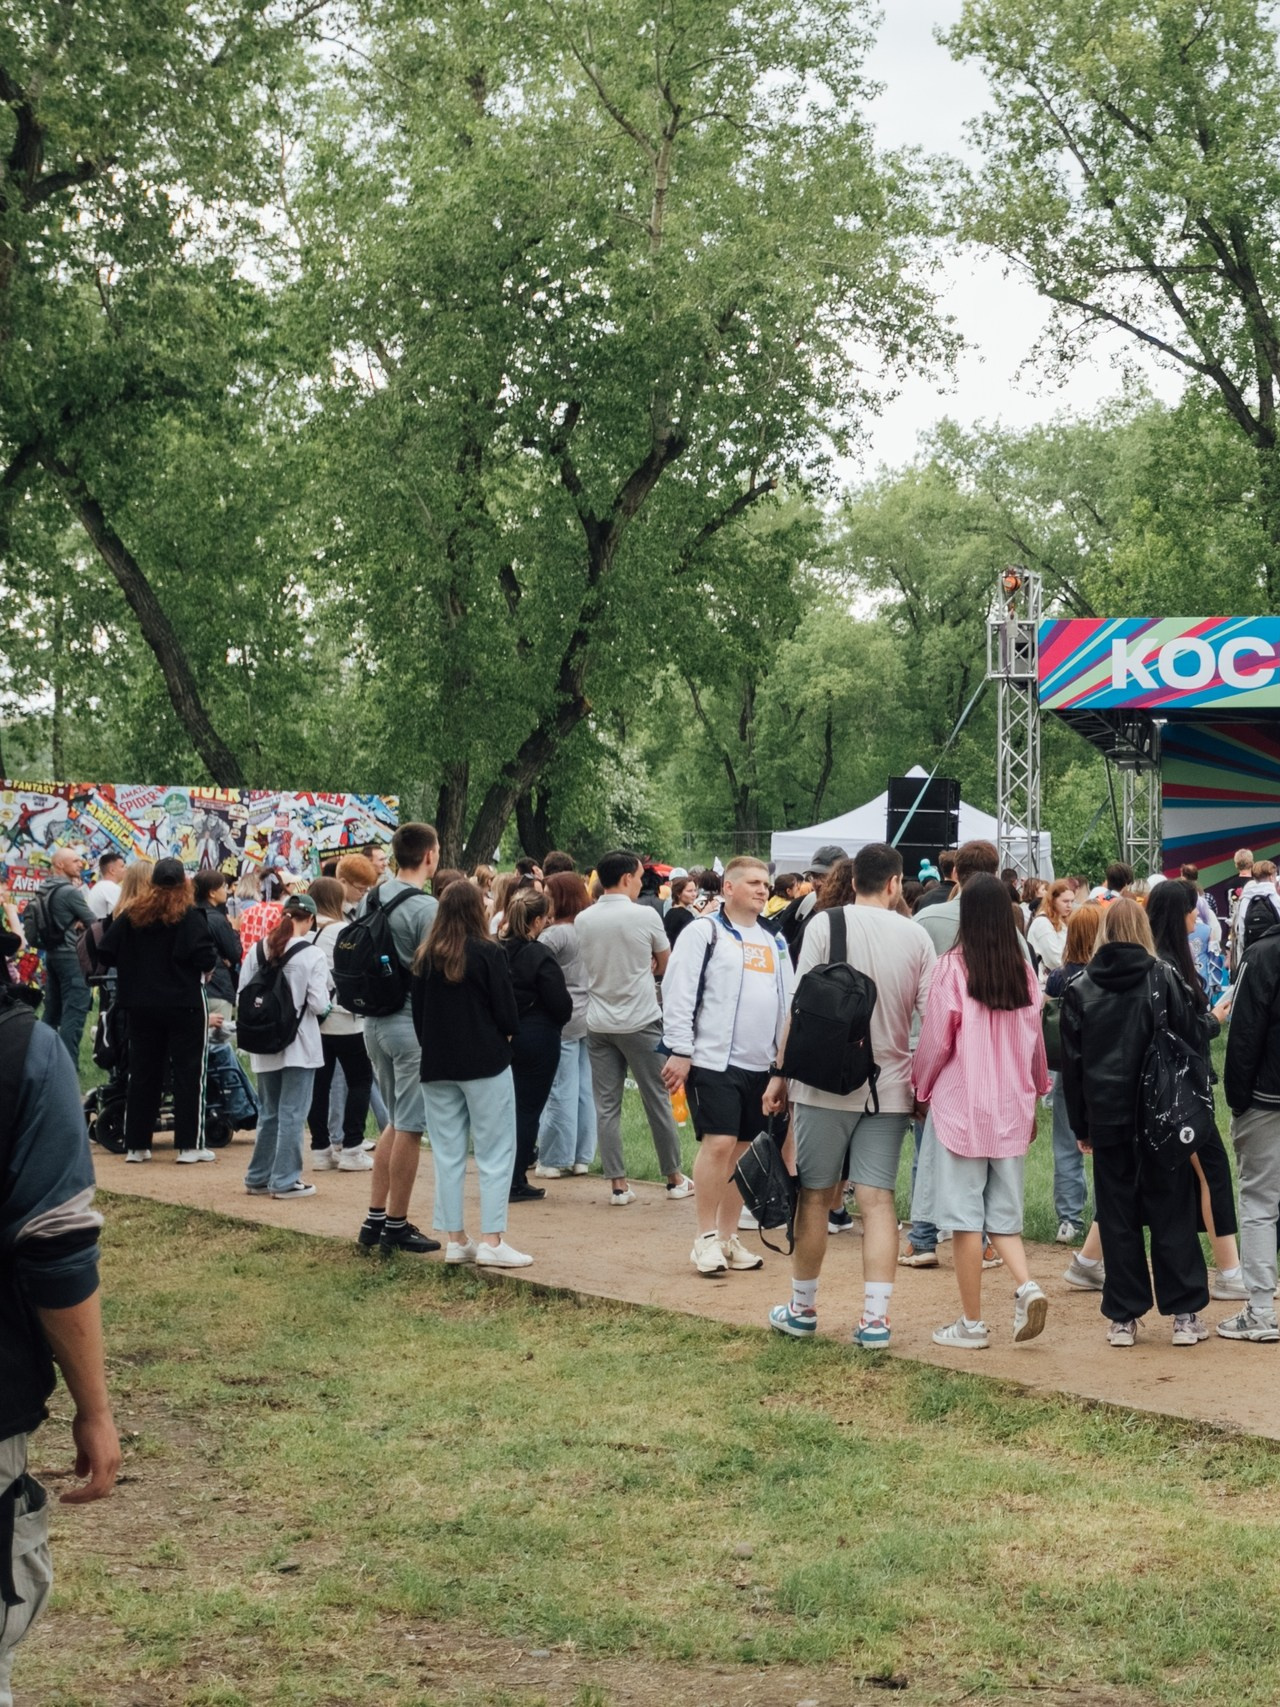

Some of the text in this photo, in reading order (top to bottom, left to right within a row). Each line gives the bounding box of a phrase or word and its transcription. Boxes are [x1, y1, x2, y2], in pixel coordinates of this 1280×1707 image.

[13, 780, 56, 794] FANTASY
[189, 787, 241, 804] HULK
[86, 803, 135, 849] AMERICA
[12, 875, 41, 892] AVEN
